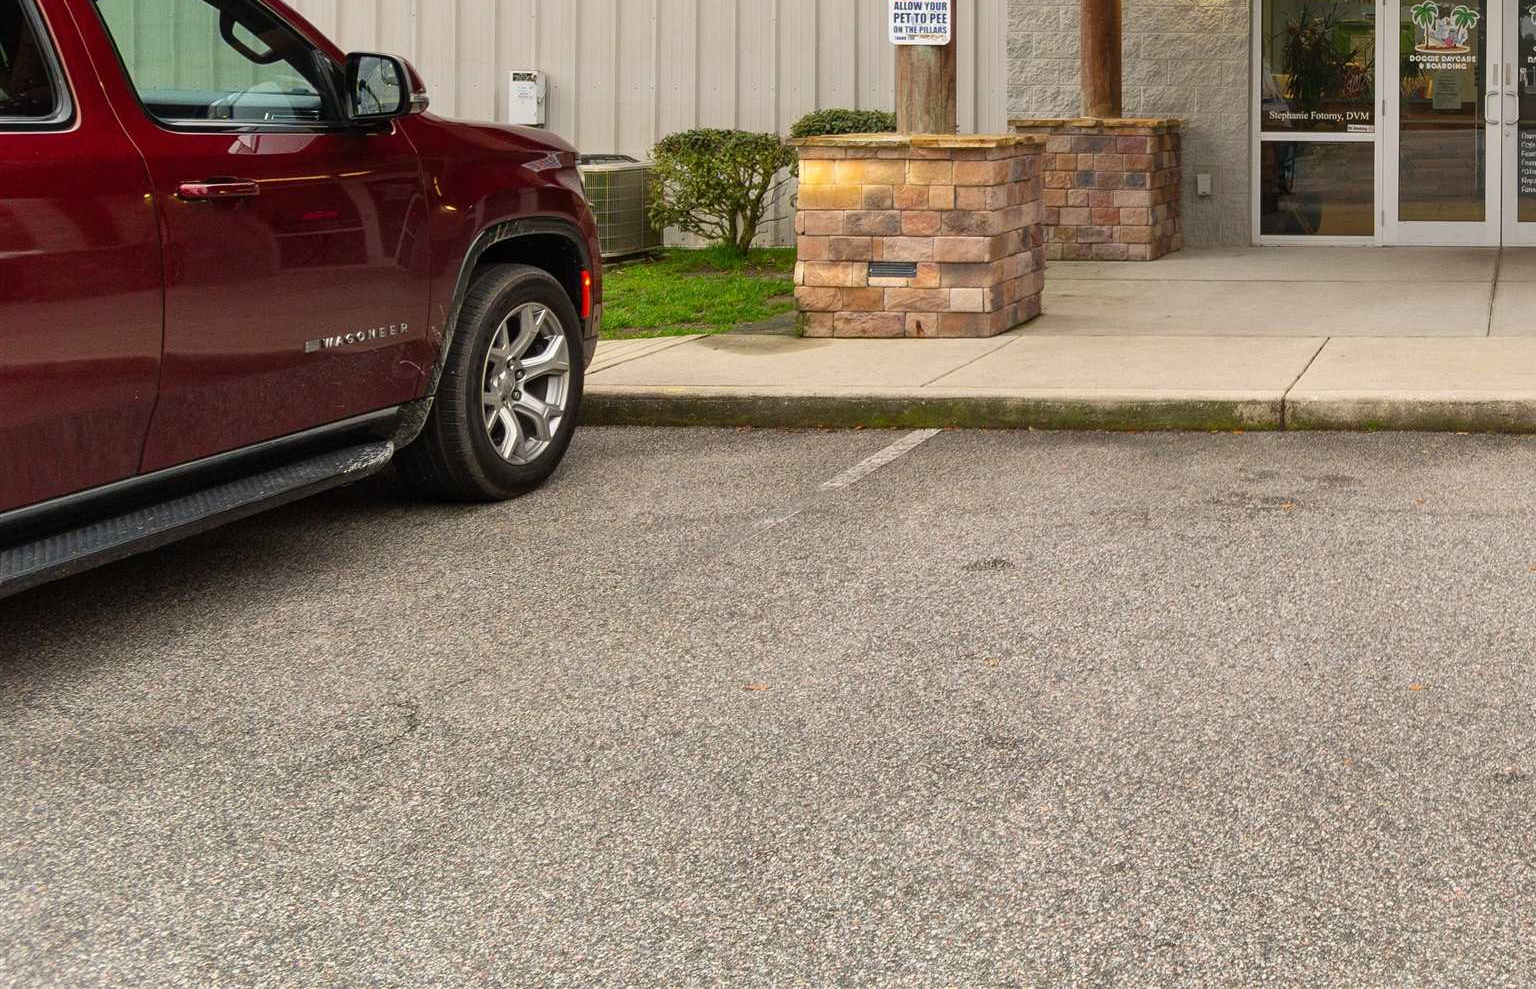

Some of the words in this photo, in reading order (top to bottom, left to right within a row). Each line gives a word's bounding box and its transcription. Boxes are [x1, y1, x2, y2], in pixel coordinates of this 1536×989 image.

[893, 1, 923, 11] ALLOW
[924, 1, 948, 11] YOUR
[893, 12, 912, 24] PET
[913, 12, 927, 24] TO
[929, 12, 948, 24] PEE
[893, 26, 903, 34] ON
[905, 26, 918, 34] THE
[919, 26, 948, 34] PILLARS
[1441, 55, 1477, 63] DAYCARE
[1269, 111, 1309, 122] Stephanie
[1346, 111, 1369, 120] DVM
[322, 322, 408, 349] WAGONEER
